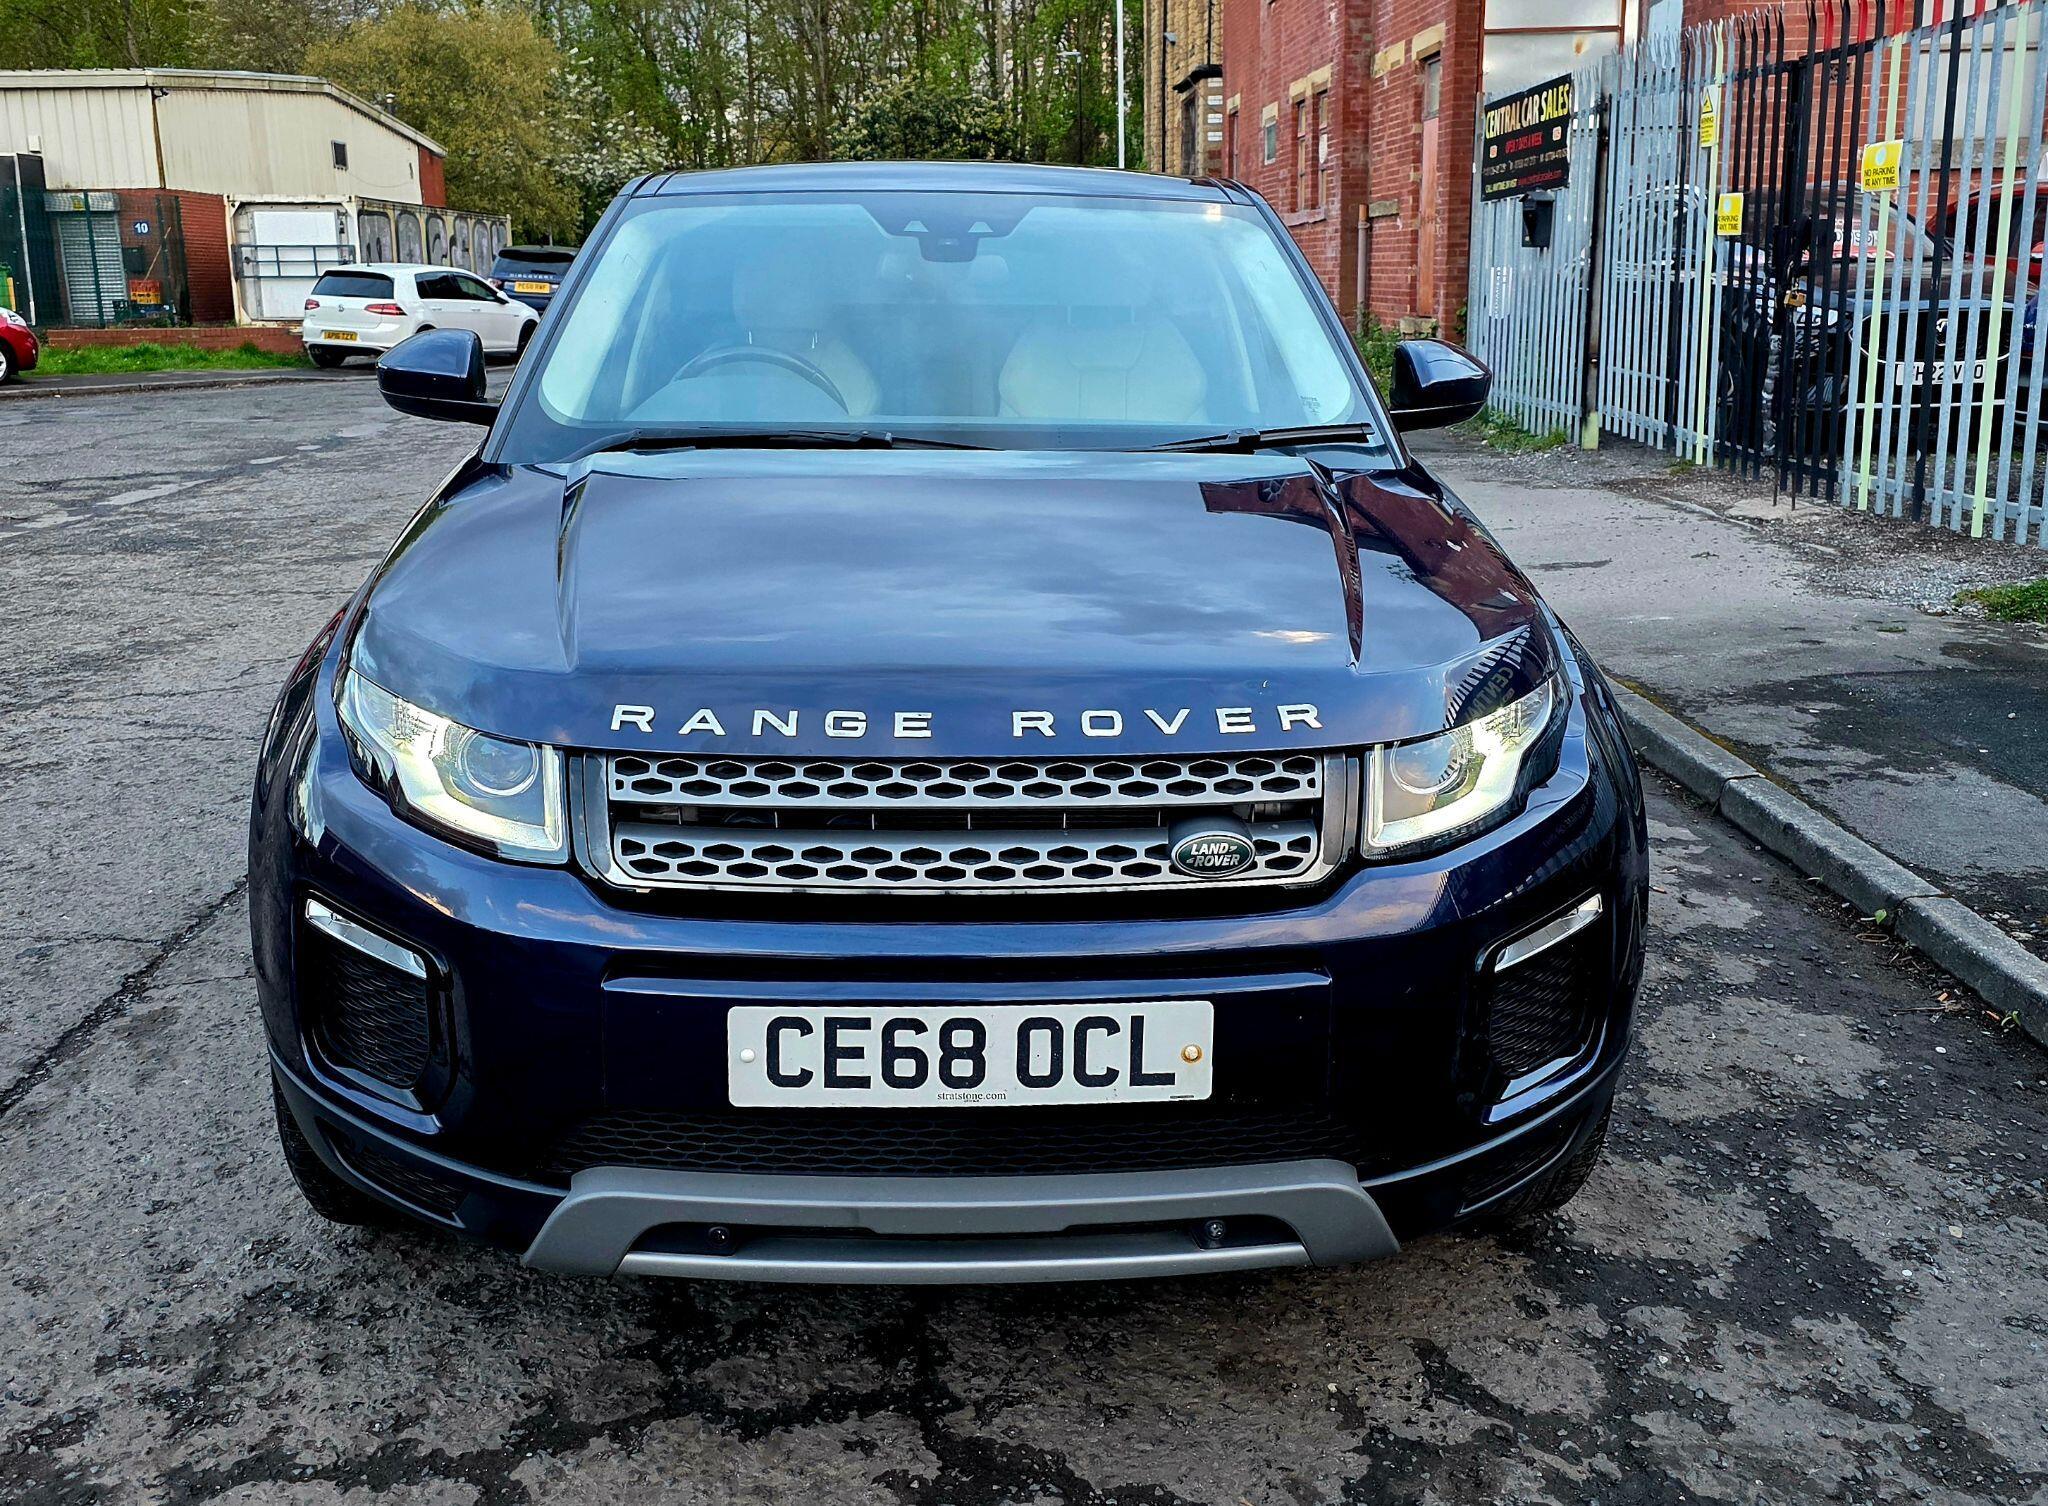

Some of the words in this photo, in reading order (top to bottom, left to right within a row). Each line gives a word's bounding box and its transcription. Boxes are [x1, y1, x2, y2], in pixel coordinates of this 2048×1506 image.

[1485, 101, 1520, 139] CENTRAL
[1521, 94, 1540, 128] CAR
[1540, 83, 1570, 122] SALES
[1864, 169, 1871, 177] NO
[1872, 166, 1895, 176] PARKING
[1865, 179, 1871, 187] AT
[1872, 178, 1881, 186] ANY
[1882, 176, 1895, 184] TIME
[1720, 214, 1739, 222] PARKING
[134, 222, 149, 234] 10
[1953, 364, 1984, 380] VO
[610, 704, 932, 738] RANGE
[1011, 703, 1323, 737] ROVER
[1190, 842, 1229, 855] LAND
[1193, 853, 1240, 867] ROVER
[765, 1015, 987, 1089] CE68
[1015, 1015, 1176, 1089] OCL
[937, 1092, 1006, 1100] stratstone.com
